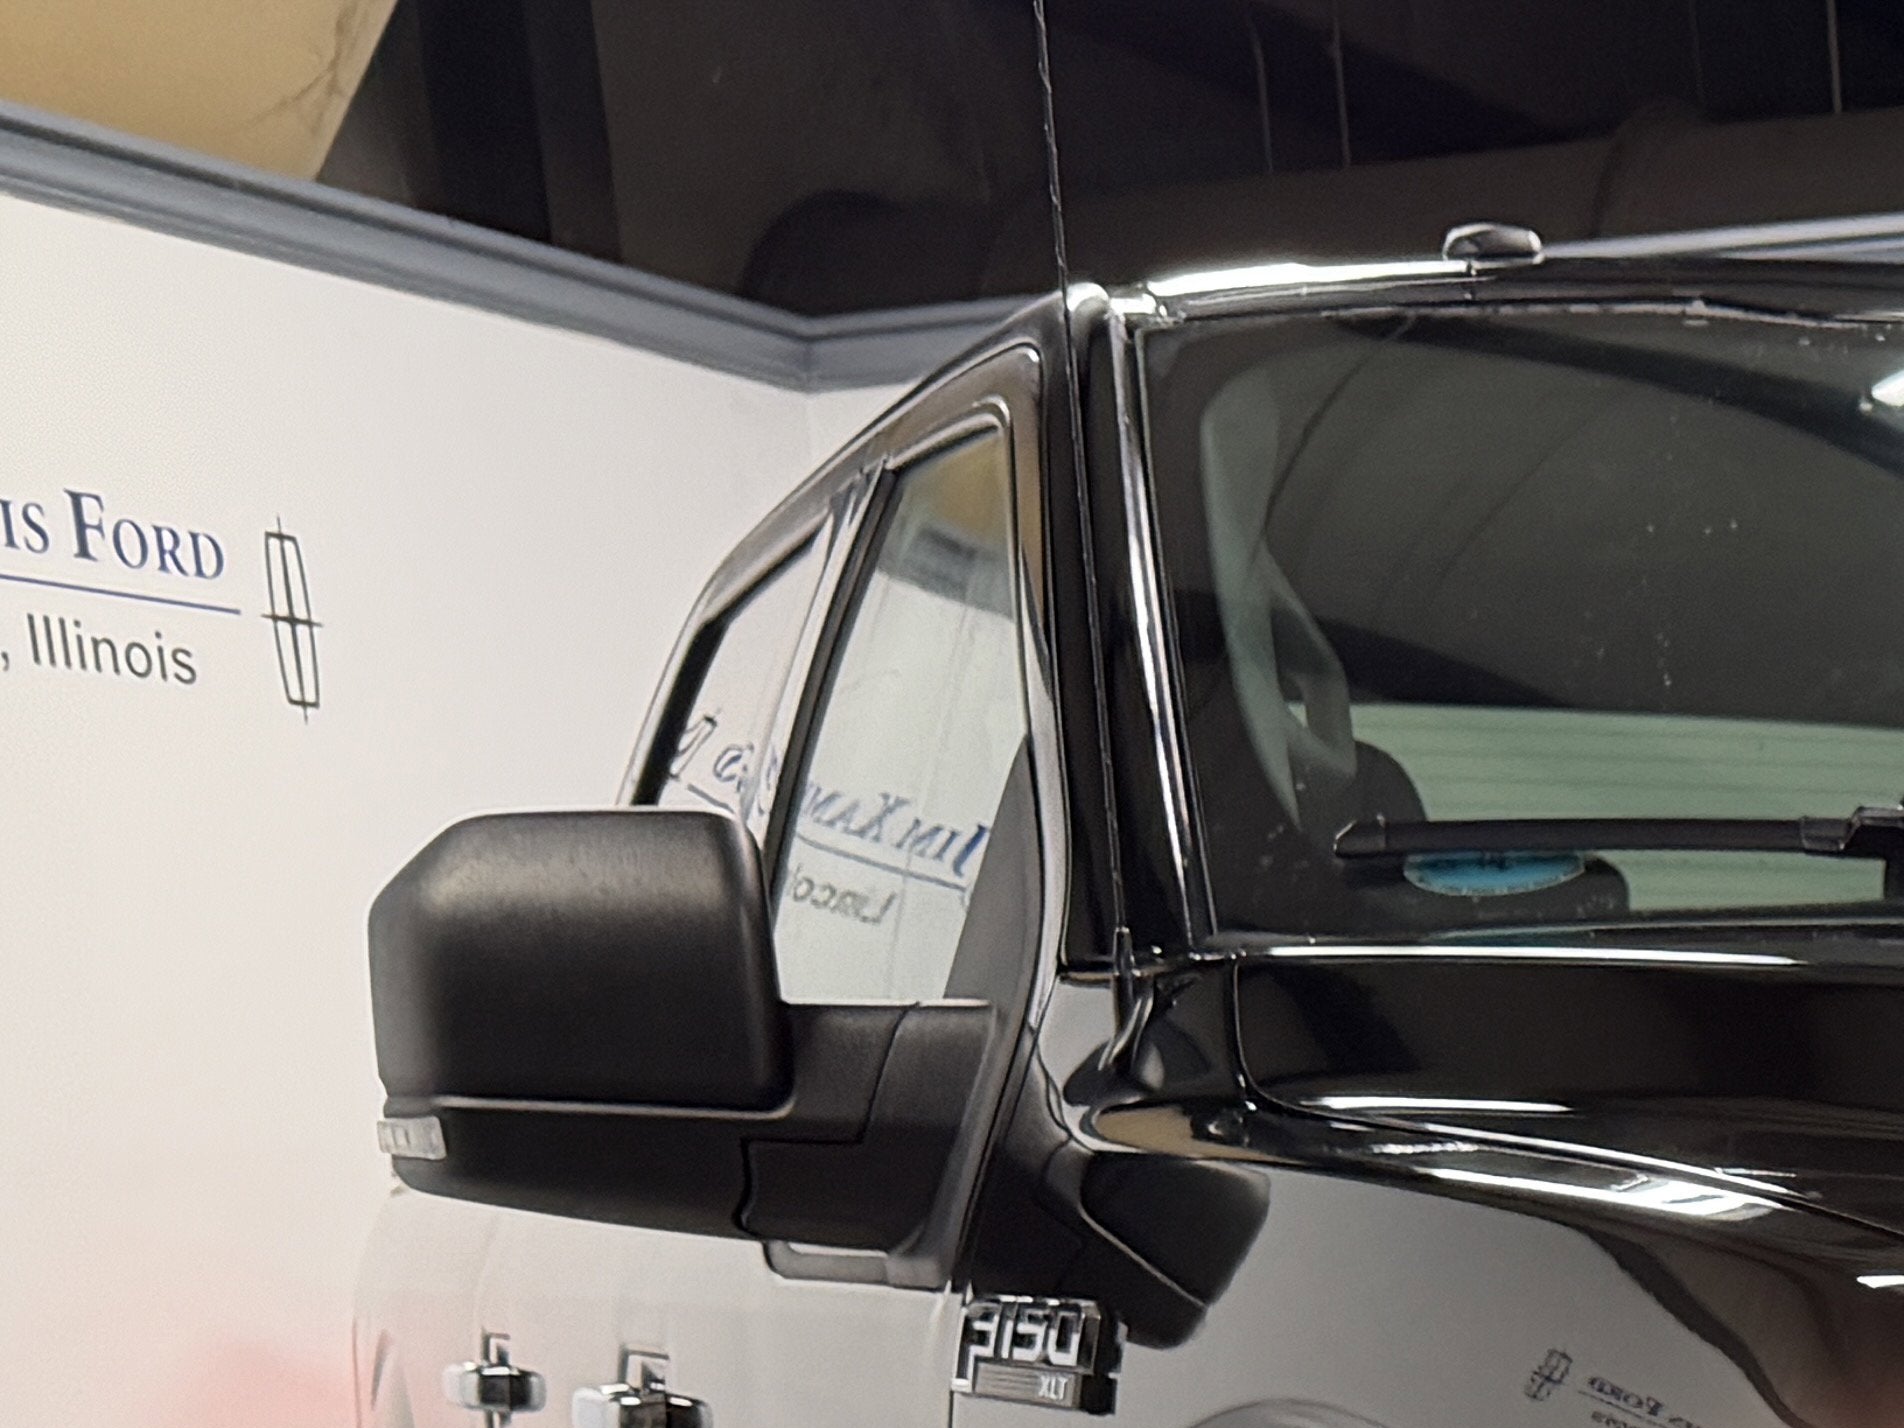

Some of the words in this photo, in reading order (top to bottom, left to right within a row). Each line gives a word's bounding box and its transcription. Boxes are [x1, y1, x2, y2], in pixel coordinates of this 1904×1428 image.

[63, 488, 225, 581] FORD
[27, 612, 197, 685] Illinois
[1037, 1374, 1070, 1401] XLT
